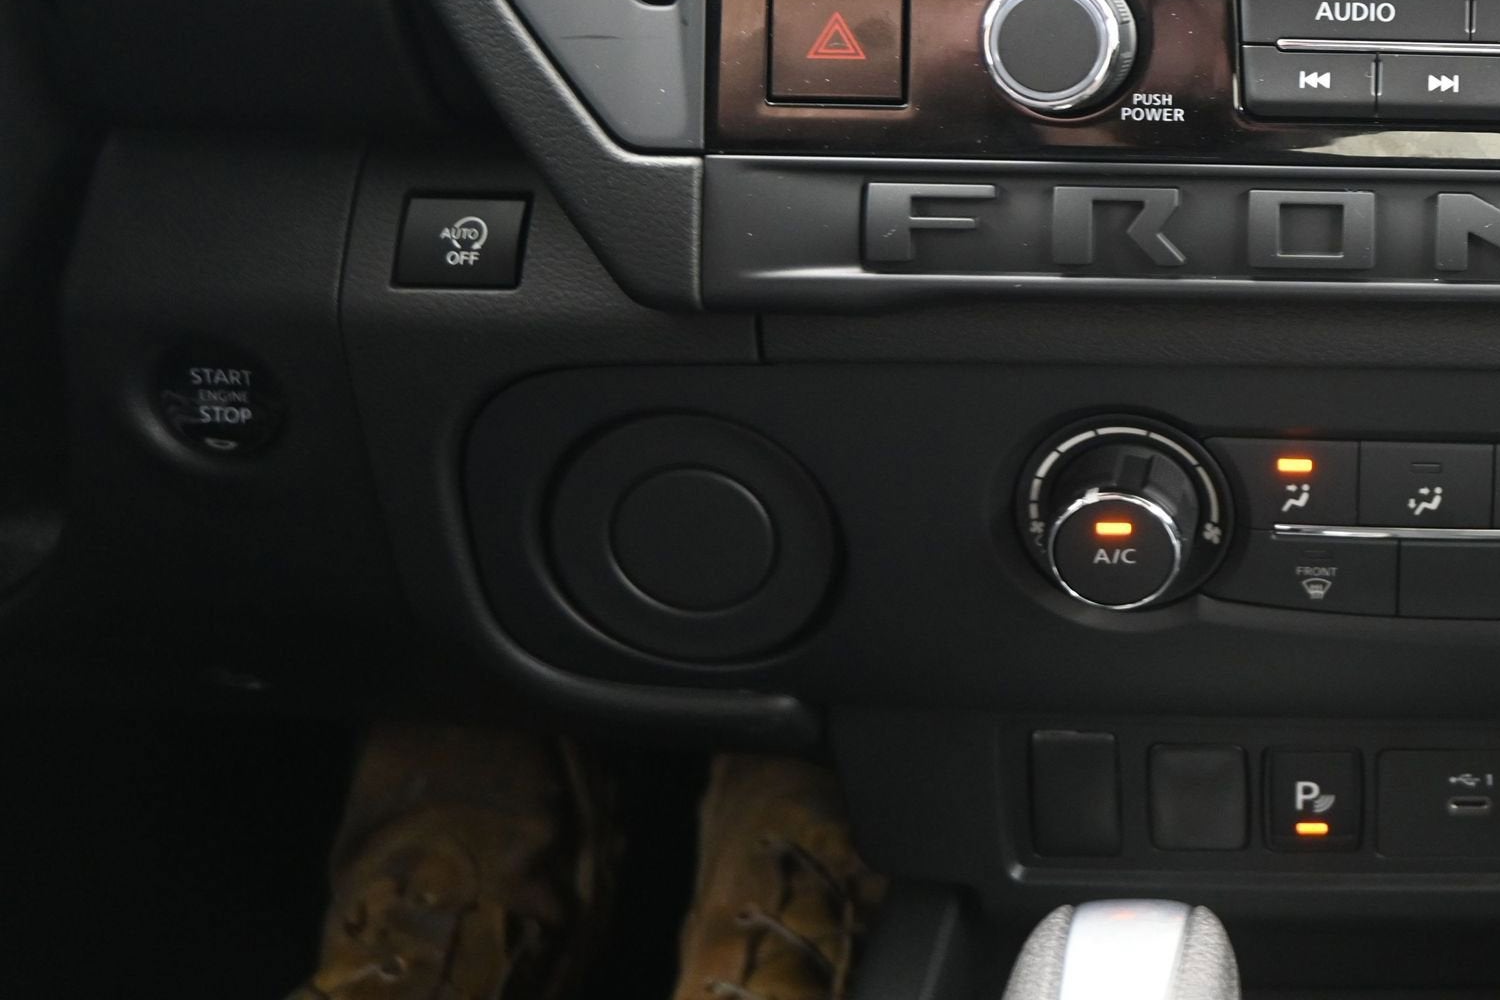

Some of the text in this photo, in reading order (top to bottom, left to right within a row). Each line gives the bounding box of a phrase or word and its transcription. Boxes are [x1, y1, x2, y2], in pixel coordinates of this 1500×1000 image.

[1314, 1, 1396, 23] AUDIO
[1132, 93, 1174, 107] PUSH
[1120, 107, 1186, 123] POWER
[439, 226, 481, 242] AUTO
[445, 250, 480, 267] OFF
[189, 366, 253, 388] START
[198, 405, 254, 425] STOP
[1092, 547, 1138, 566] A/C
[1295, 565, 1338, 578] FRONT
[1484, 773, 1495, 787] 1
[1295, 780, 1322, 811] P
